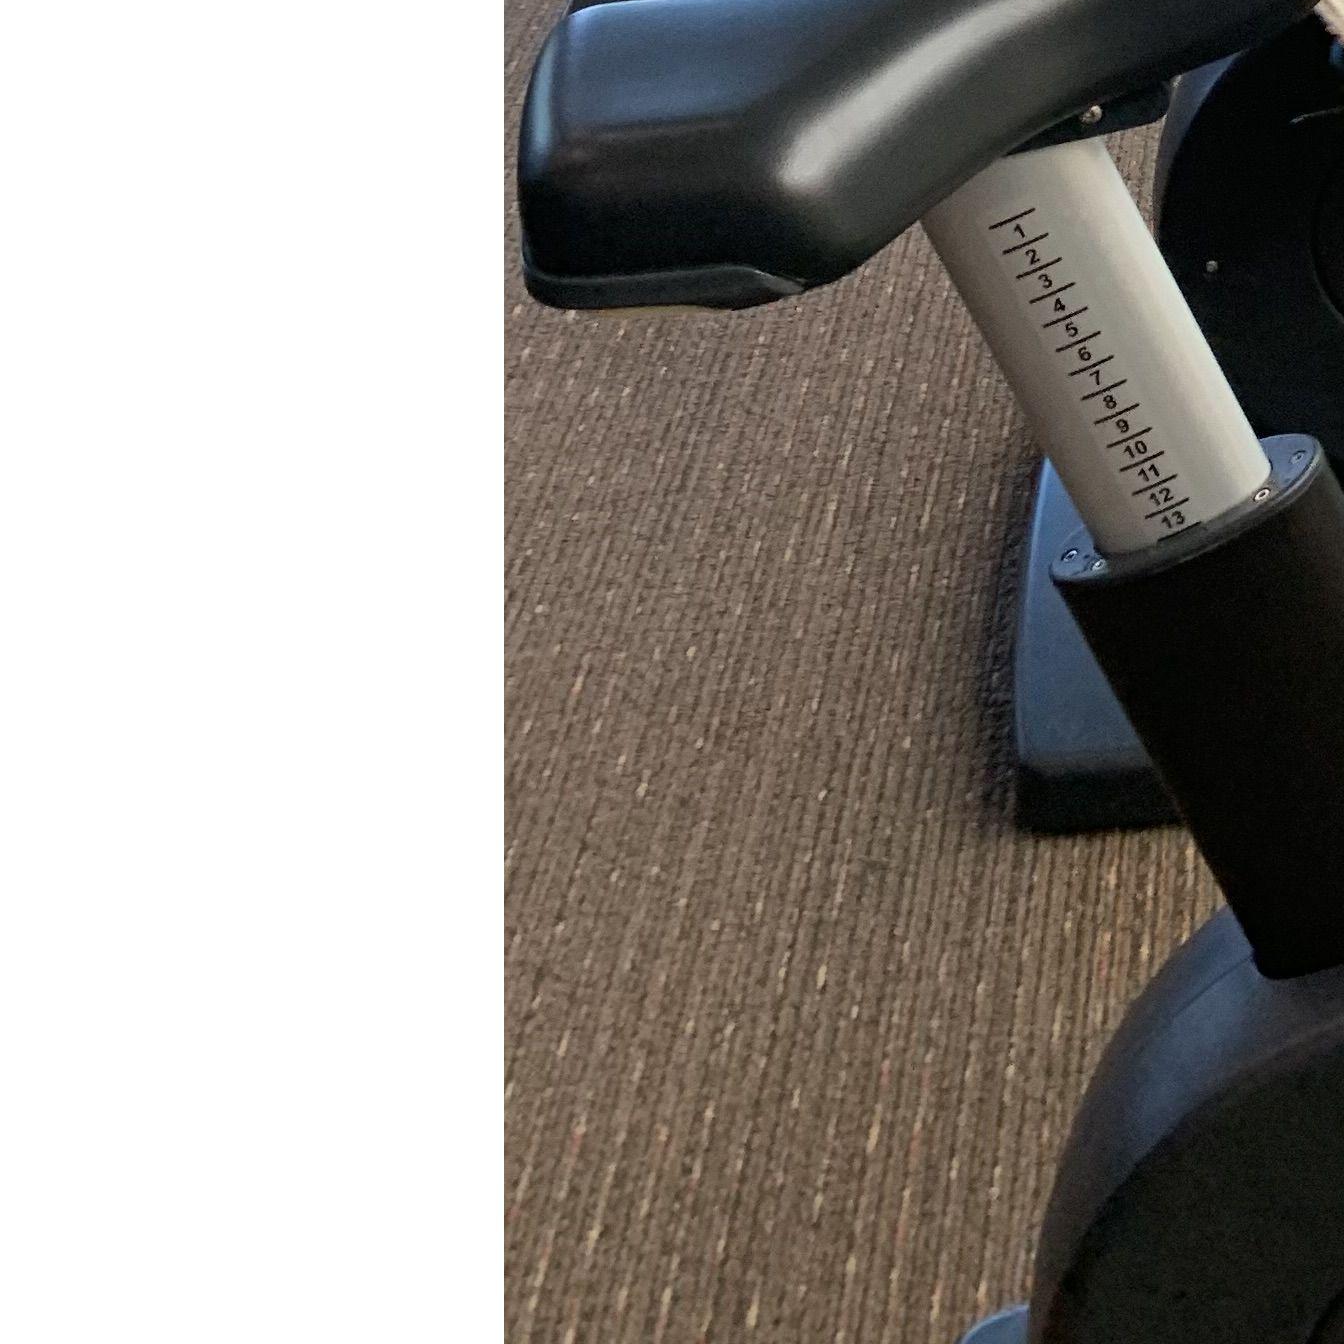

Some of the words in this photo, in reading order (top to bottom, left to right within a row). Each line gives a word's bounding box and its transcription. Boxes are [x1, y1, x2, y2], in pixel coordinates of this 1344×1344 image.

[1014, 224, 1025, 238] 1
[1025, 249, 1040, 265] 2
[1038, 274, 1052, 288] 3
[1054, 297, 1065, 312] 4
[1065, 321, 1078, 337] 5
[1078, 346, 1091, 361] 6
[1090, 370, 1100, 385] 7
[1103, 395, 1117, 409] 8
[1115, 419, 1129, 433] 9
[1123, 440, 1147, 458] 10
[1137, 464, 1160, 482] 11
[1150, 487, 1174, 506] 12
[1161, 511, 1185, 529] 13
